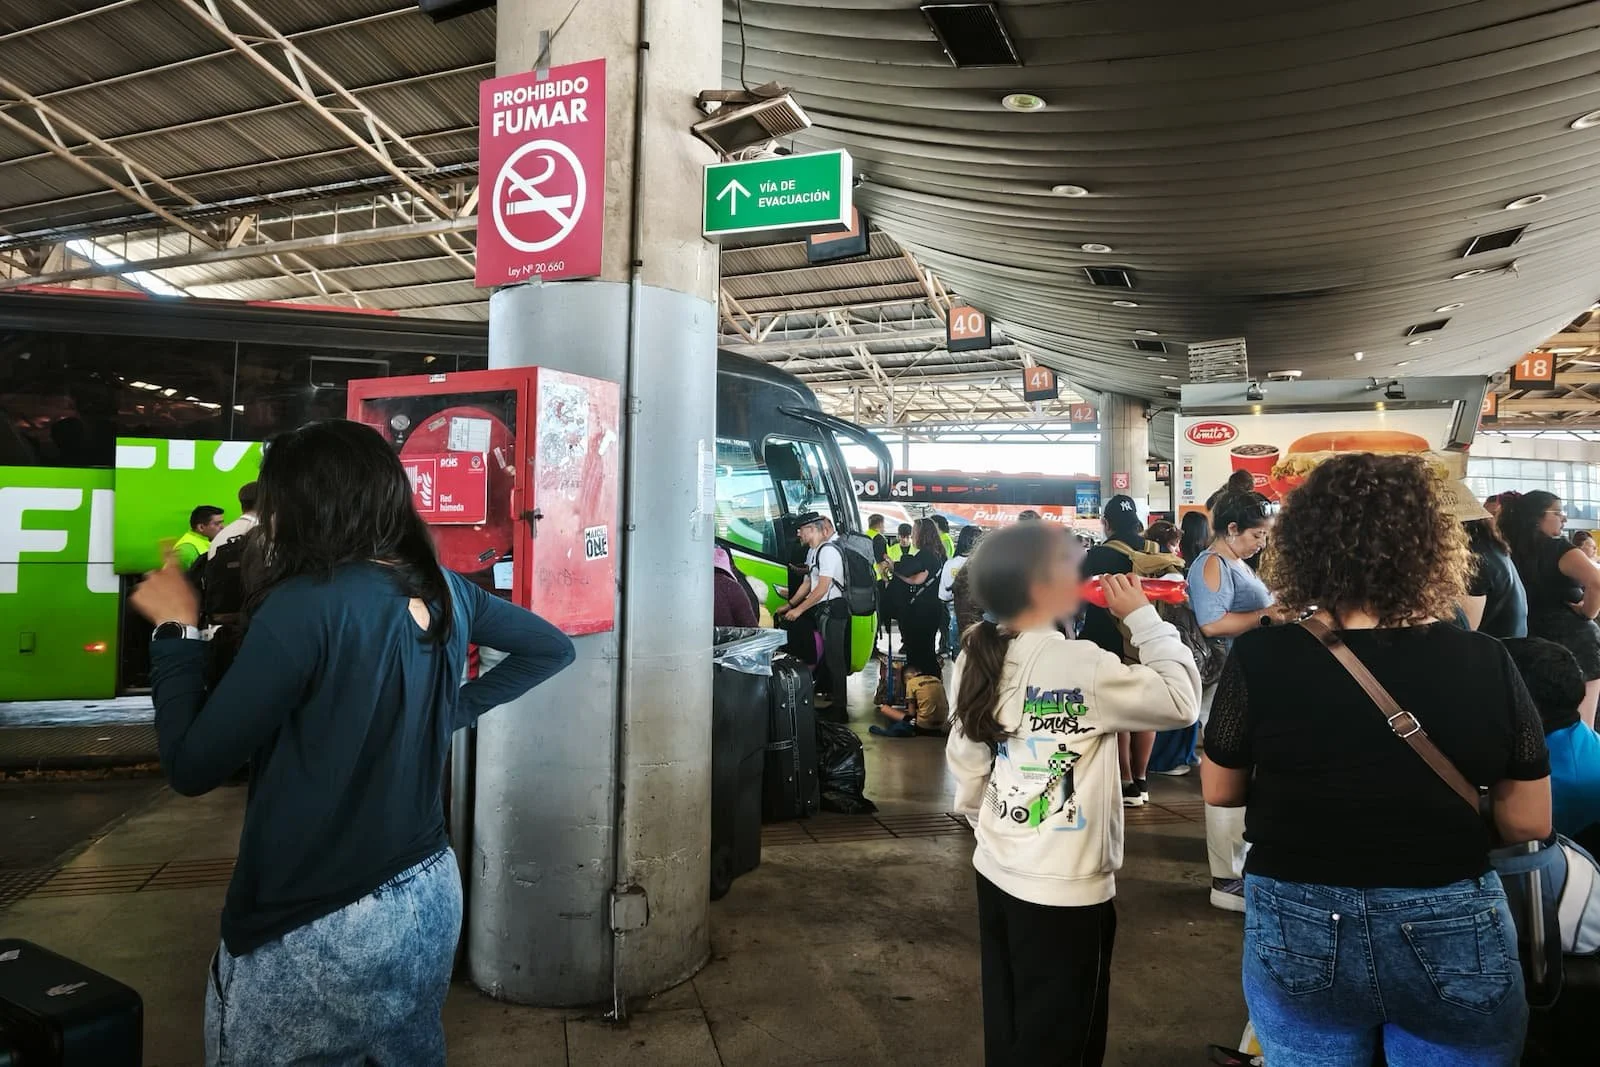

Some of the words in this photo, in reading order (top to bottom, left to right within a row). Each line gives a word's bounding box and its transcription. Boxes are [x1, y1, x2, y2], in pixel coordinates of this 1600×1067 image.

[493, 76, 588, 107] PROHIBIDO
[493, 98, 588, 136] FUMAR
[759, 180, 778, 193] VÍA
[780, 179, 796, 191] DE
[758, 190, 831, 208] EVACUACIÓN
[508, 266, 521, 278] Ley
[535, 260, 565, 273] 20.660
[952, 312, 983, 335] 40
[1521, 359, 1547, 377] 18
[1030, 371, 1050, 389] 41
[1073, 407, 1093, 421] 42
[440, 494, 452, 503] Red
[972, 509, 1020, 521] Pullm
